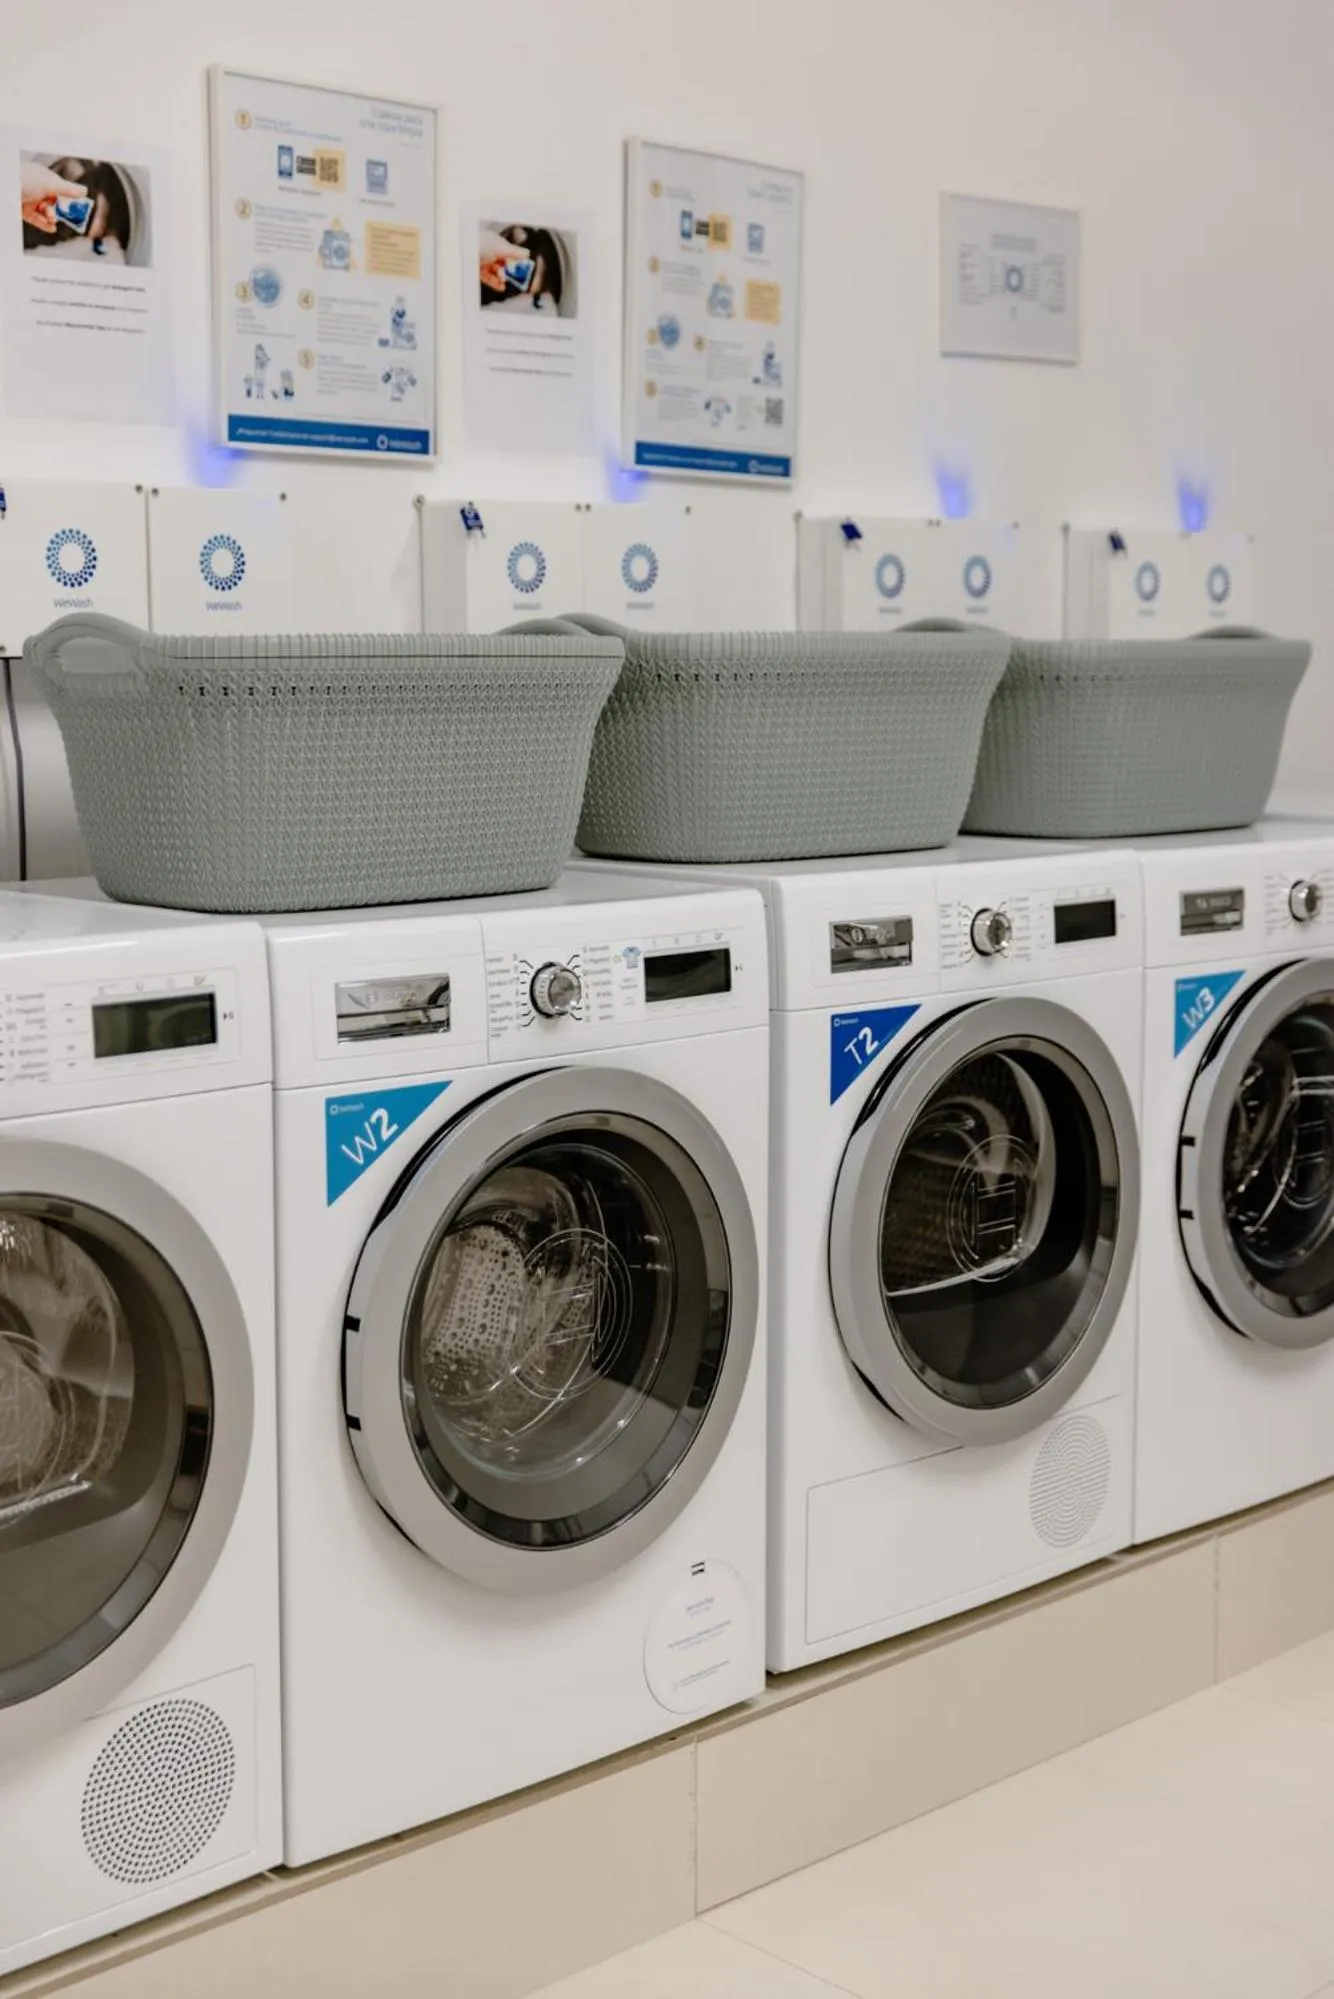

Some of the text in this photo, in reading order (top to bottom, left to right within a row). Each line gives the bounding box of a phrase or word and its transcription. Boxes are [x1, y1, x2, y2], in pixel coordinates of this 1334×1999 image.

[1181, 986, 1215, 1029] W3
[844, 1026, 879, 1064] T2
[340, 1107, 399, 1164] W2
